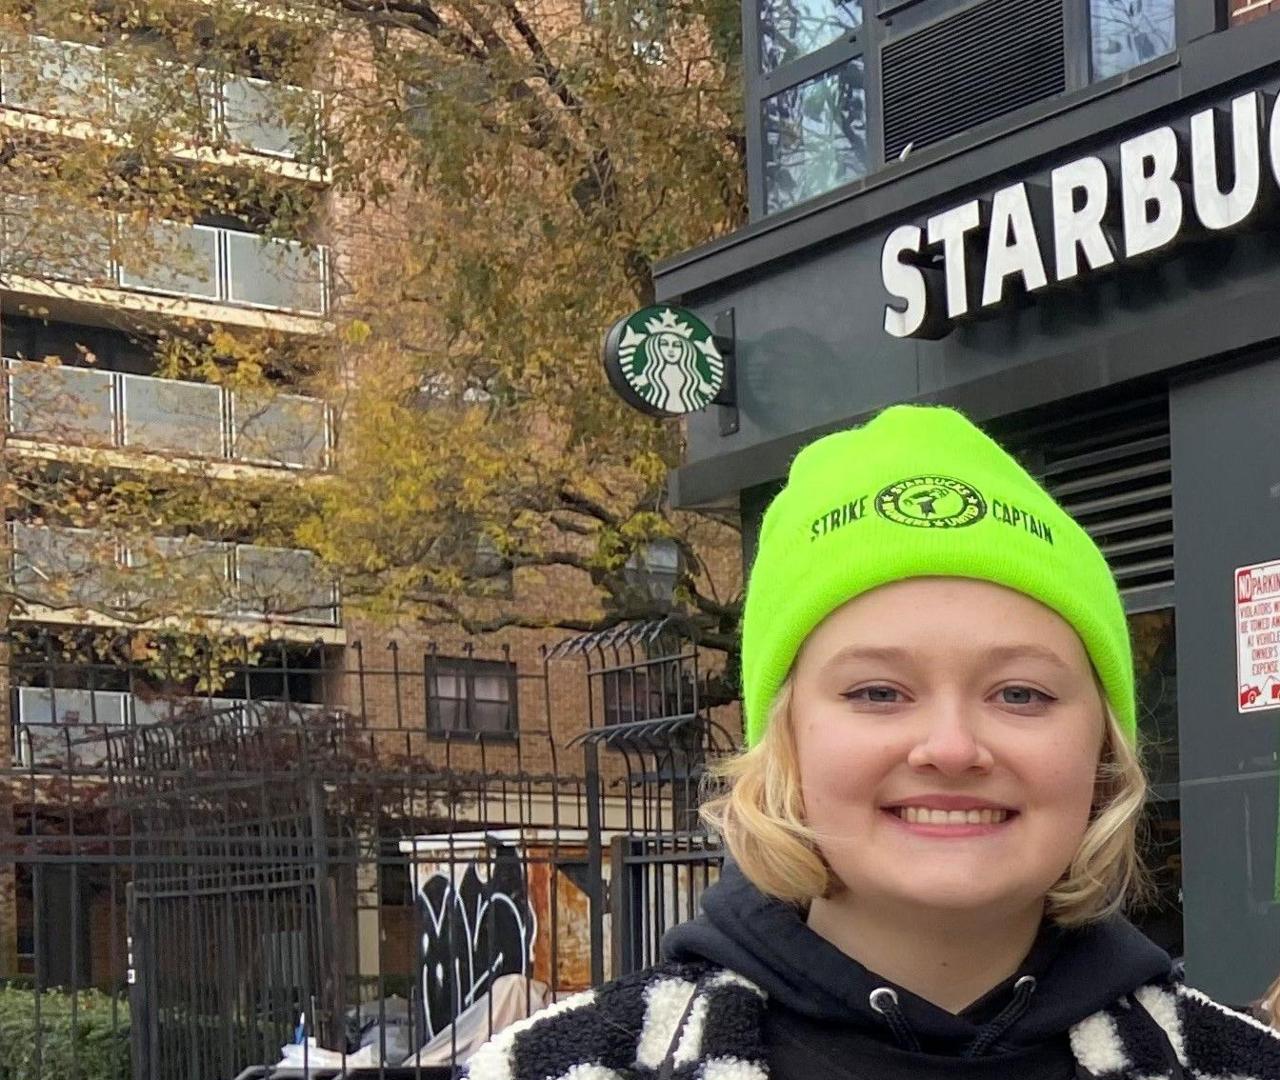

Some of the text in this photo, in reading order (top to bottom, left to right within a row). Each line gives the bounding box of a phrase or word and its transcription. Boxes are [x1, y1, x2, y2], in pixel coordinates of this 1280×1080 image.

[811, 494, 868, 542] STRIKE
[992, 498, 1053, 546] CAPTAIN
[1239, 574, 1252, 600] NO
[1252, 660, 1279, 675] EXPENSE
